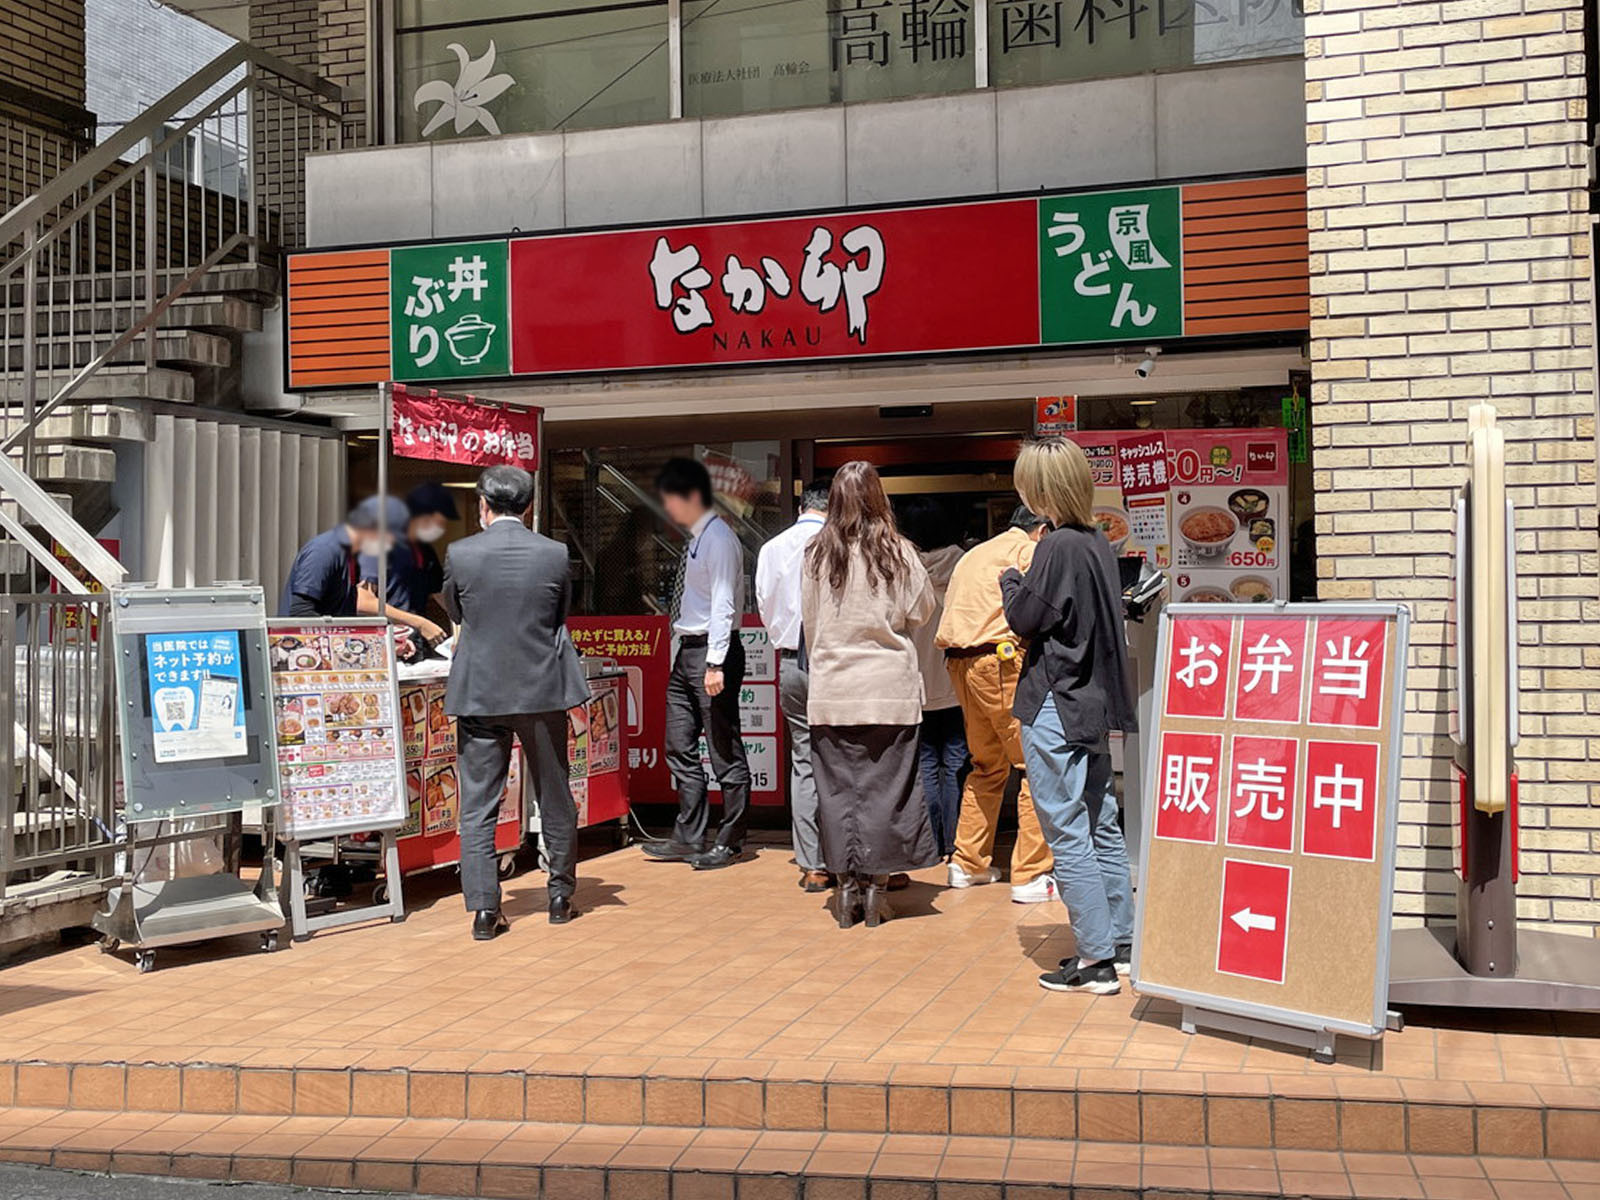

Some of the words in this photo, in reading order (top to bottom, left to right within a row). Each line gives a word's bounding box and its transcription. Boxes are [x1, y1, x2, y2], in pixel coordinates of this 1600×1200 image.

[1115, 208, 1153, 265] 京風
[650, 226, 885, 343] なか卯
[1047, 210, 1158, 329] うどん
[403, 255, 488, 368] 丼ぶり
[713, 325, 822, 351] NAKAU
[398, 412, 534, 460] なか卯のお弁当
[1120, 441, 1164, 460] キャッシュレス
[1122, 460, 1167, 488] 券売機
[152, 639, 208, 653] 当医院では
[153, 652, 234, 668] ネット予約が
[574, 643, 651, 656] つのご予約方法
[1176, 633, 1370, 699] お弁当
[1162, 754, 1364, 829] 販売中
